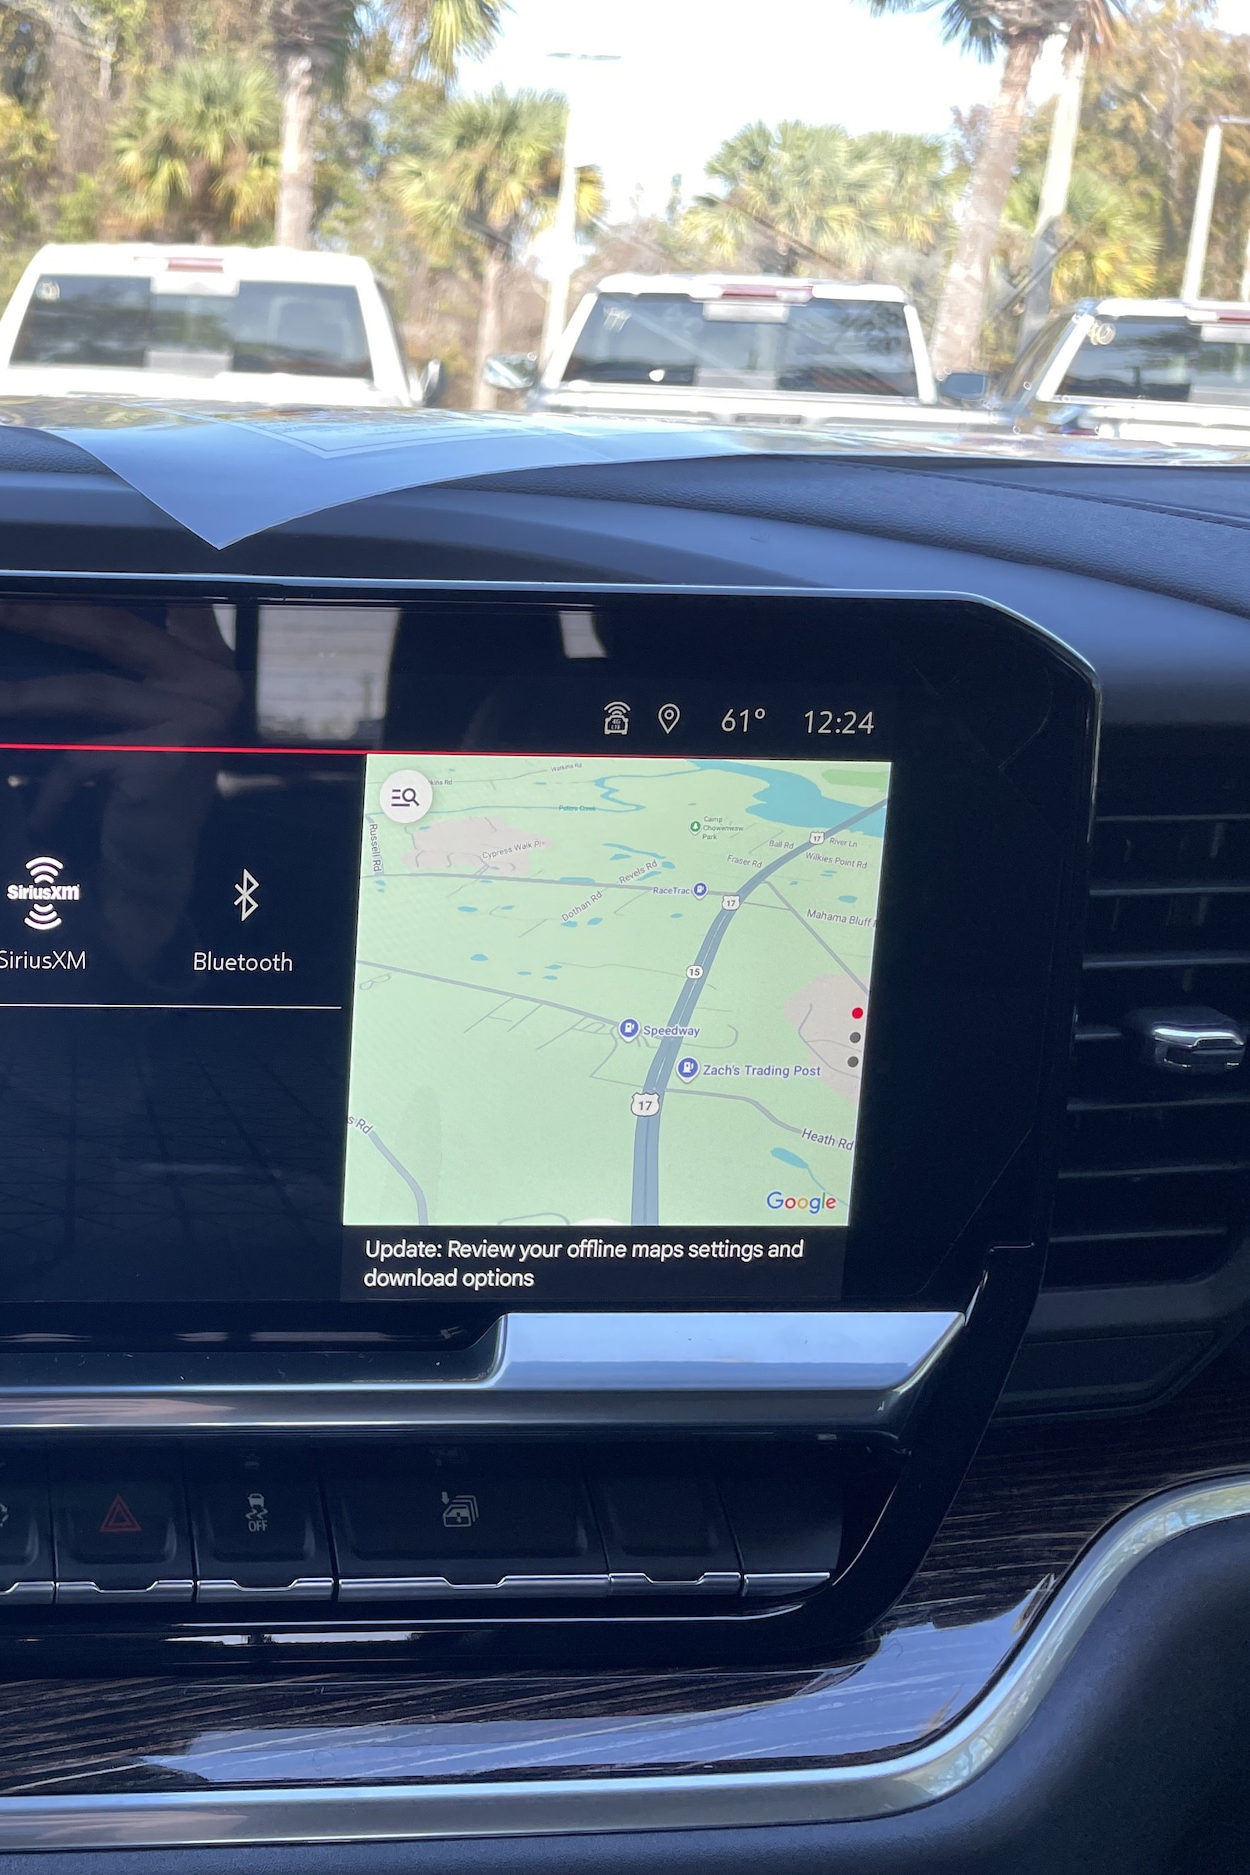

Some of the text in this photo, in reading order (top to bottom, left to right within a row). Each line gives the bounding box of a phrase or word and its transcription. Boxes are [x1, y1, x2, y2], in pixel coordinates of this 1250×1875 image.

[804, 710, 875, 735] 12:24
[482, 847, 513, 860] Cypress
[513, 841, 532, 851] Walk
[645, 860, 658, 870] Rd
[751, 859, 763, 869] Rd
[856, 859, 868, 869] Rd
[653, 886, 690, 895] RaceTrac
[561, 891, 603, 922] Dothan Rd
[806, 909, 847, 924] Mahama
[848, 916, 873, 928] Bluff
[193, 951, 293, 972] Bluetooth
[689, 967, 700, 977] 15
[643, 1026, 700, 1038] Speedway
[703, 1065, 821, 1078] Zach's Trading Post
[638, 1100, 653, 1112] 17
[801, 1128, 855, 1151] Heath Rd
[766, 1191, 837, 1215] Google
[365, 1239, 804, 1263] Update: Review your offline maps settings and
[363, 1268, 535, 1291] download options
[248, 1520, 267, 1532] OFF
